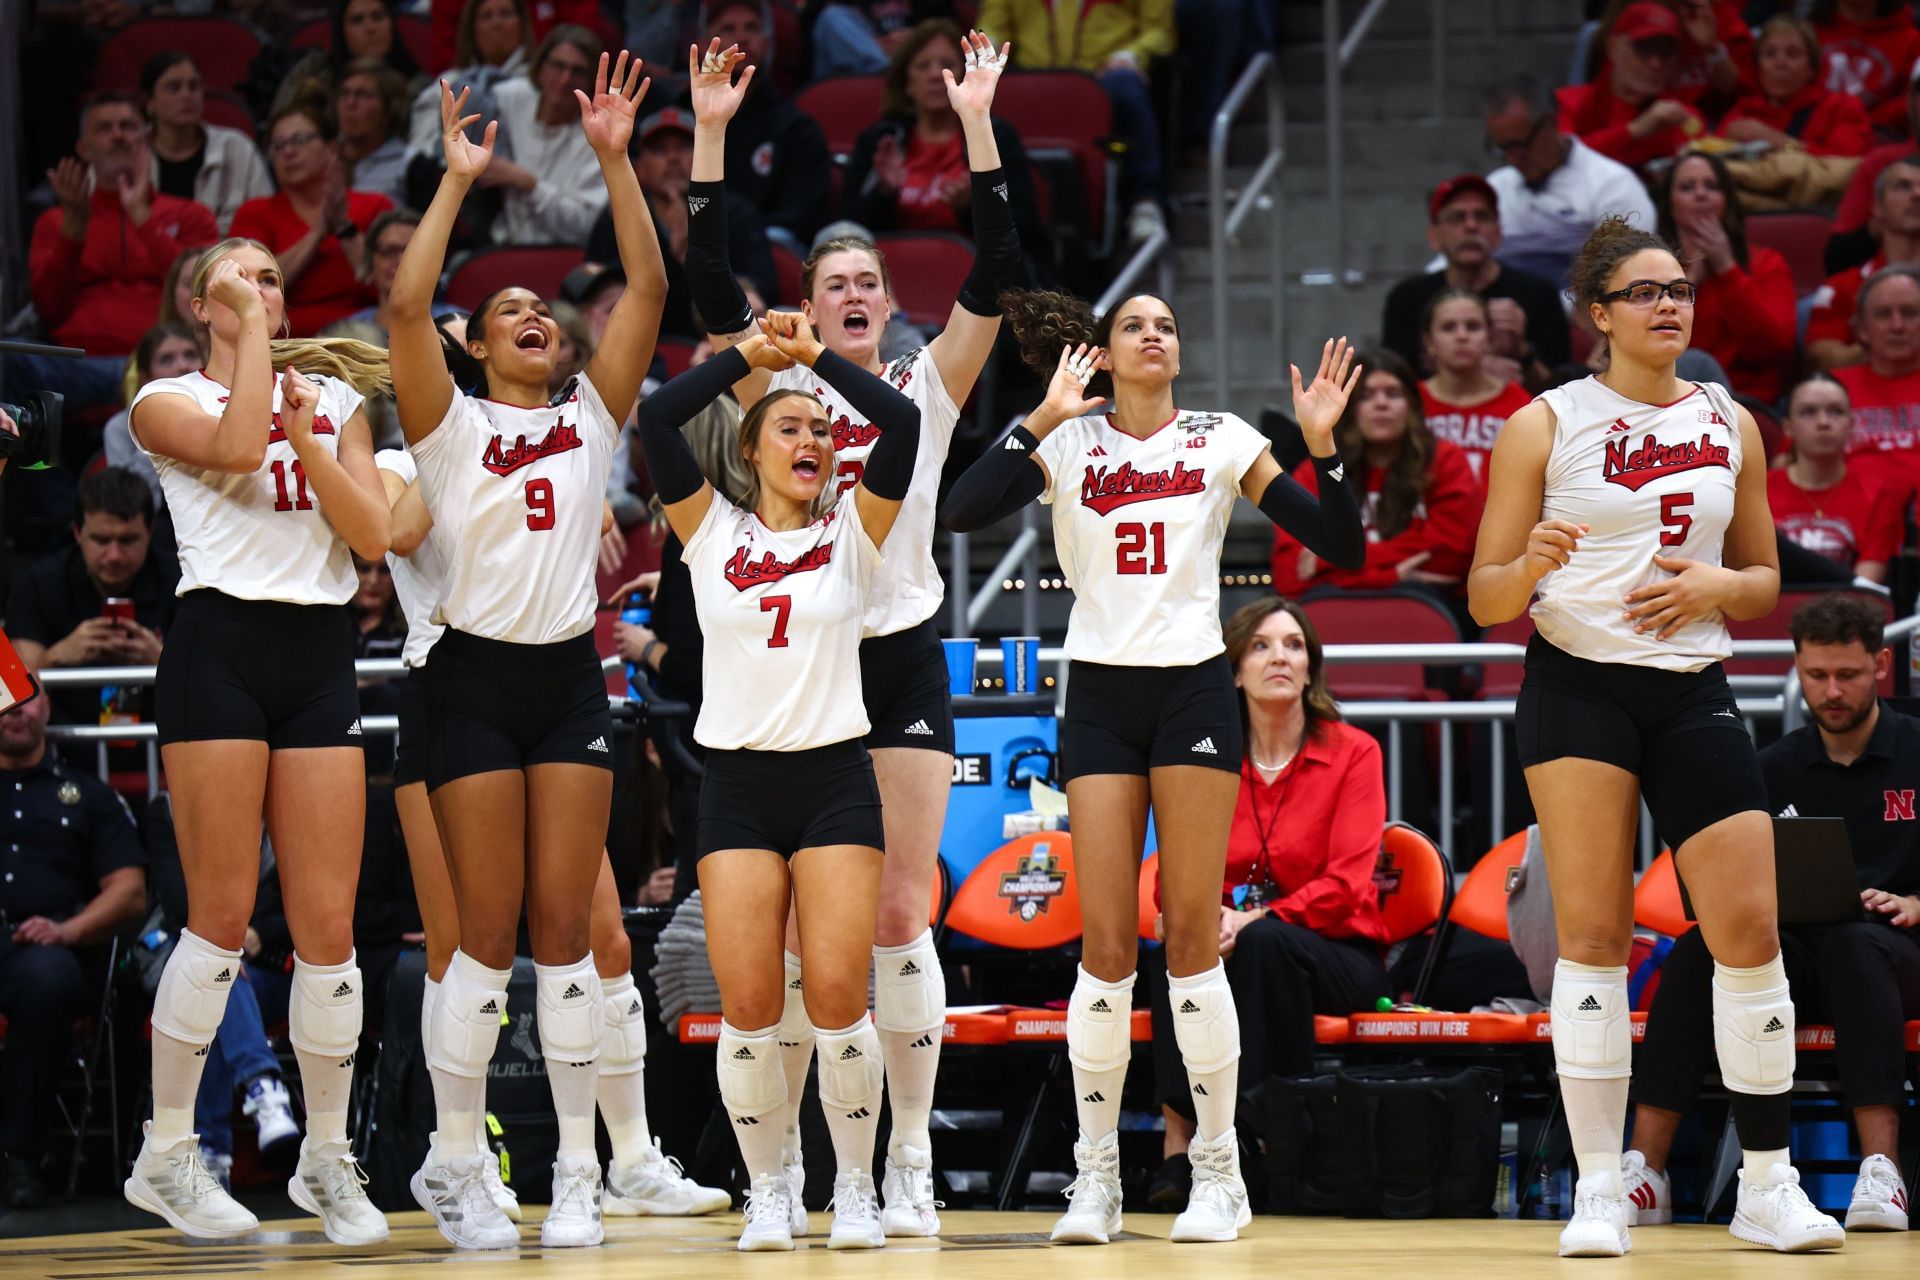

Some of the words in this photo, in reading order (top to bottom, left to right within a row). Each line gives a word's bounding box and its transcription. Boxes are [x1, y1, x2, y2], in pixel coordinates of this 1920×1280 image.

[1603, 434, 1731, 492] Nebraska
[270, 459, 313, 512] 11
[1081, 461, 1206, 517] Nebraska
[525, 478, 556, 532] 9
[1660, 492, 1694, 547] 5
[1115, 522, 1168, 575] 21
[760, 594, 792, 649] 7
[904, 728, 934, 736] adidas
[587, 744, 609, 753] adidas
[1191, 746, 1218, 755] adidas
[1884, 789, 1916, 821] N
[688, 1023, 721, 1038] CHAMP
[1015, 1020, 1067, 1035] CHAMPION
[1356, 1021, 1417, 1037] CHAMPIONS
[1419, 1021, 1440, 1037] WIN
[1442, 1021, 1469, 1037] HERE
[488, 1062, 546, 1078] UELL
